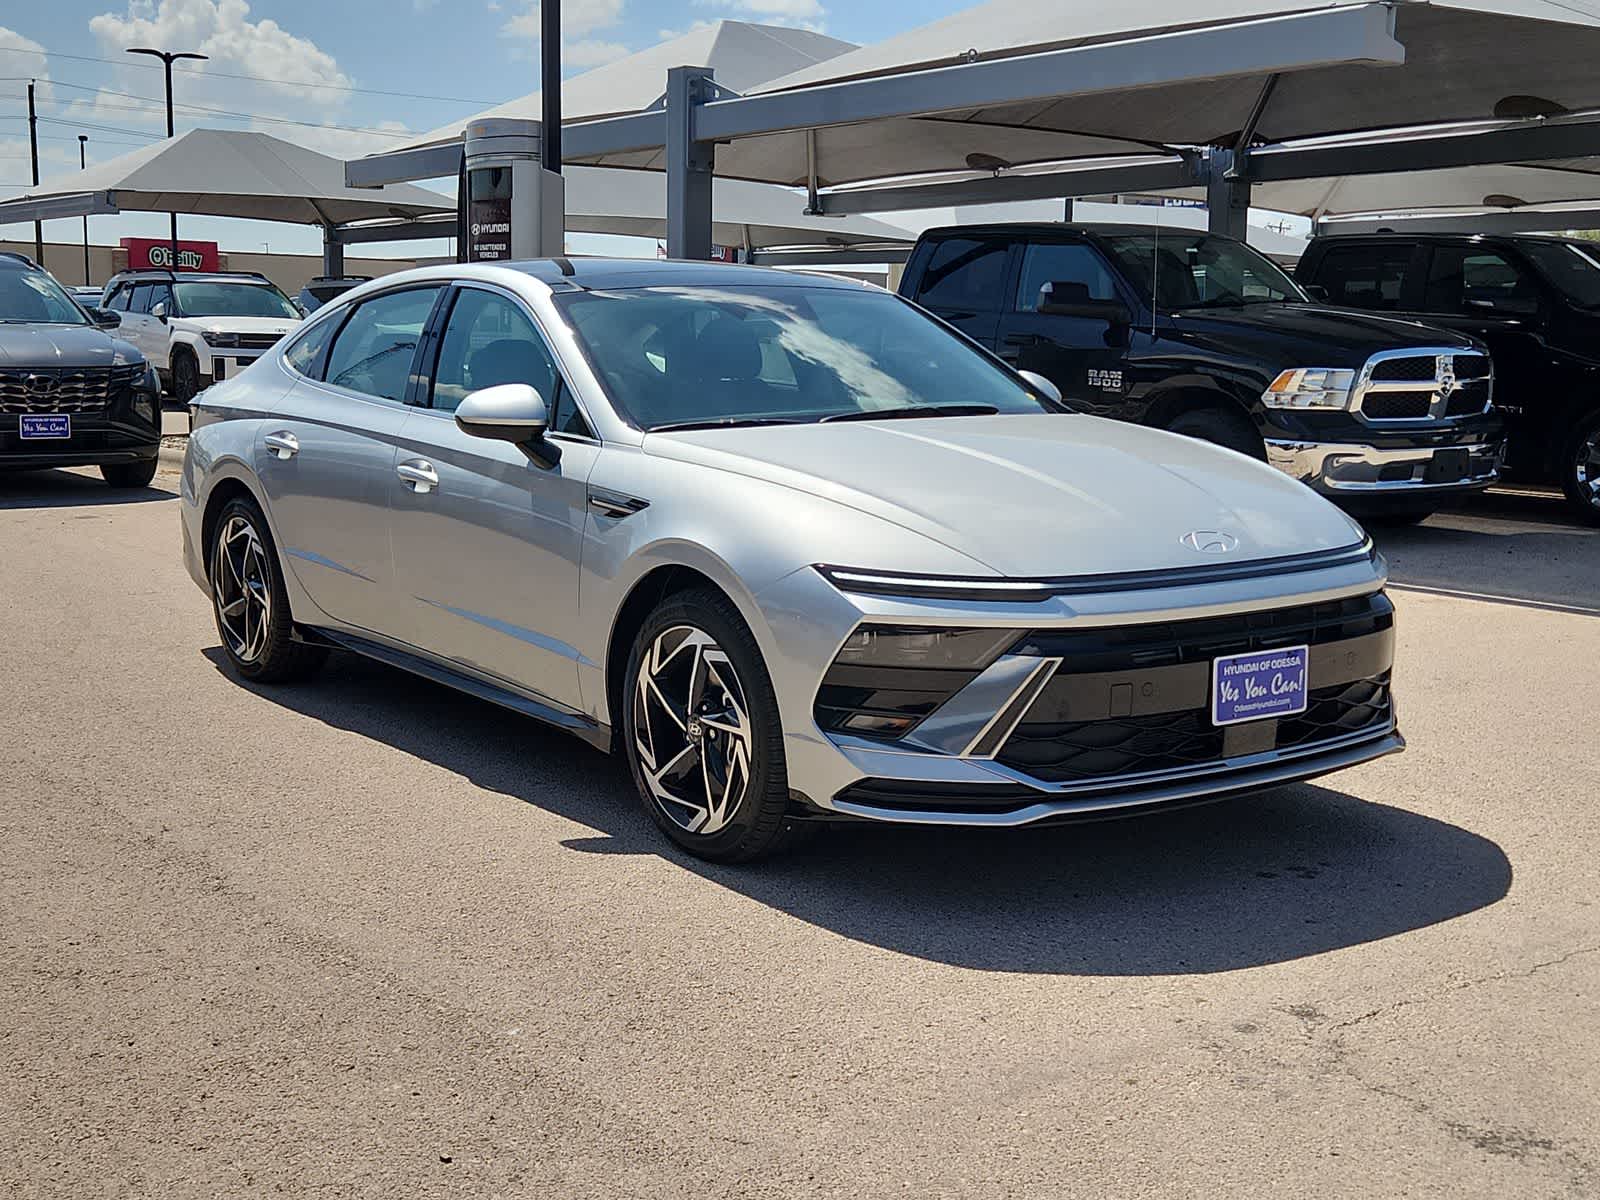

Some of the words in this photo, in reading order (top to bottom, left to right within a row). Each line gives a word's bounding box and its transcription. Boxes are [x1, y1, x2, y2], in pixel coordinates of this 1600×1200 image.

[481, 223, 510, 234] HYUNDAI
[149, 247, 203, 269] O'Reilly
[1088, 369, 1122, 379] RAM
[1088, 378, 1121, 387] 1500
[1223, 662, 1259, 676] HYUNDAI
[1260, 661, 1271, 671] OF
[1271, 656, 1301, 669] ODESSA
[1220, 680, 1240, 703] Yes
[1244, 676, 1268, 700] You
[1271, 669, 1304, 695] Can!
